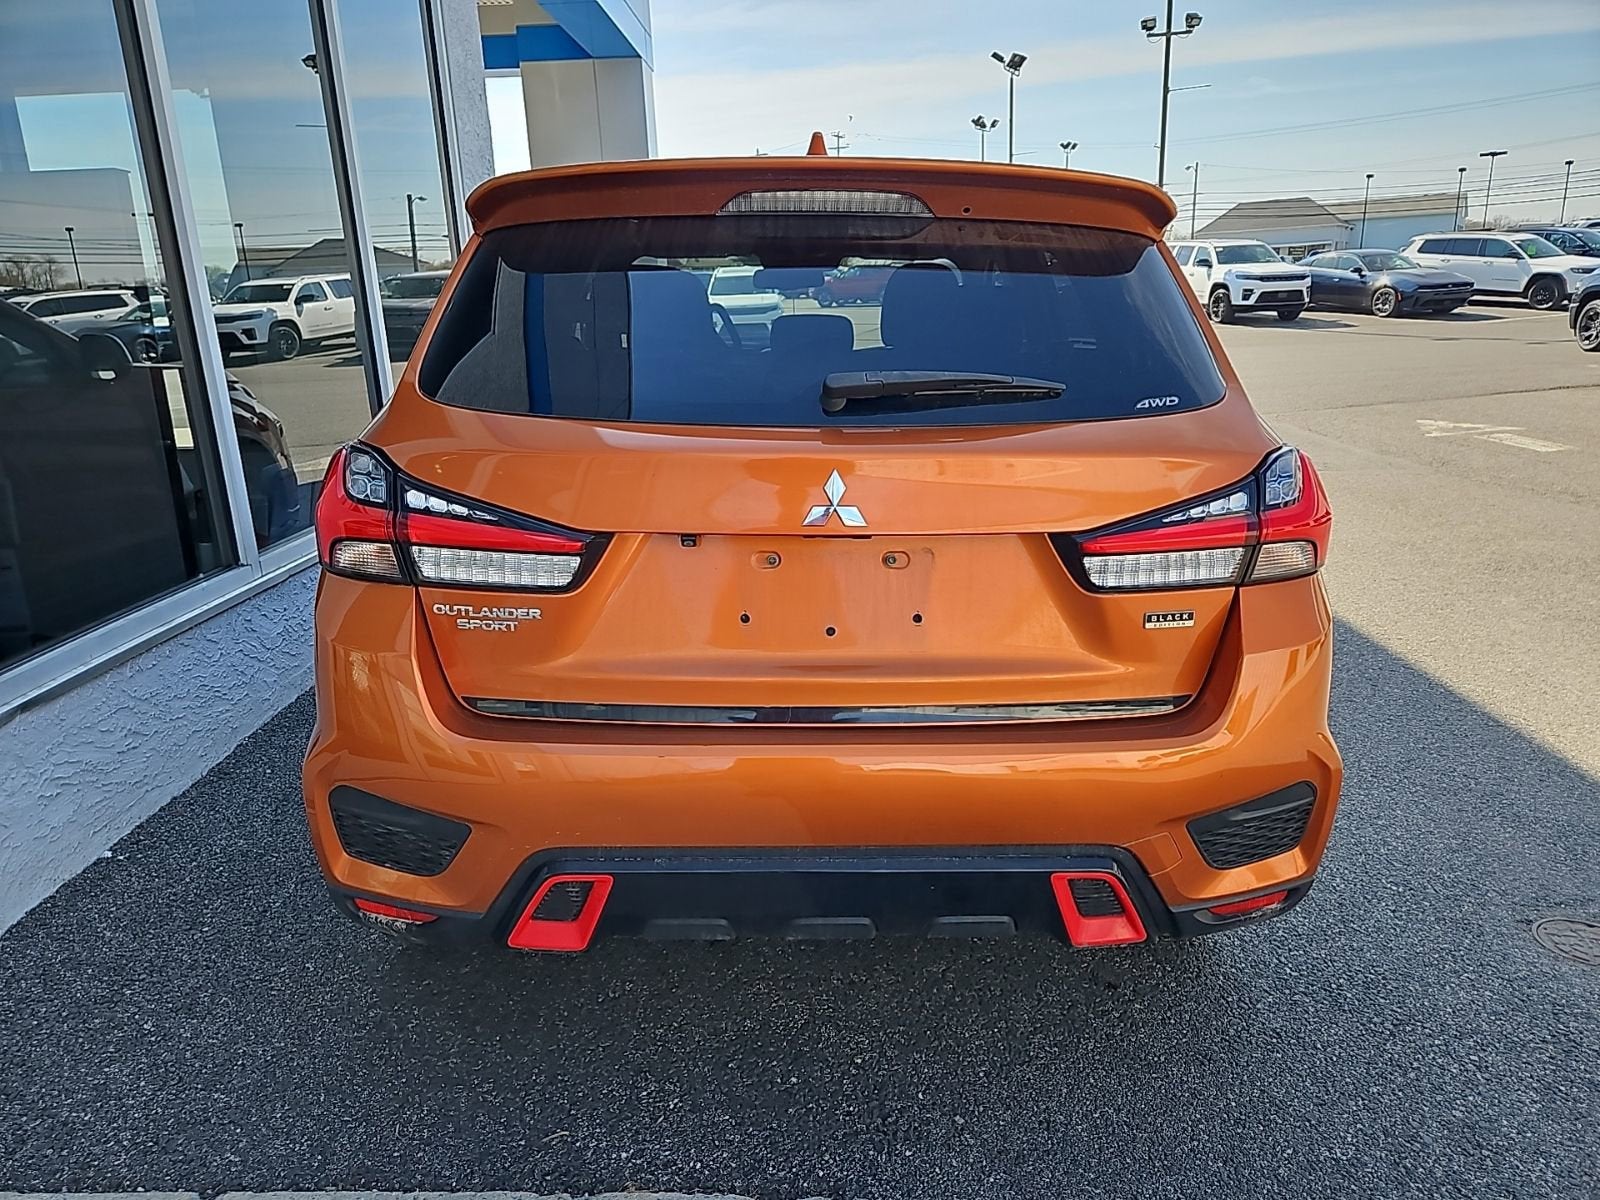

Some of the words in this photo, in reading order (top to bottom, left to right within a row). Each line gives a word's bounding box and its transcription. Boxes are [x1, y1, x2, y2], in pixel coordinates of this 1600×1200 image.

[1135, 396, 1179, 410] 4WD
[433, 603, 542, 619] OUTLANDER
[1151, 613, 1189, 622] BLACK
[457, 618, 518, 631] SPORT
